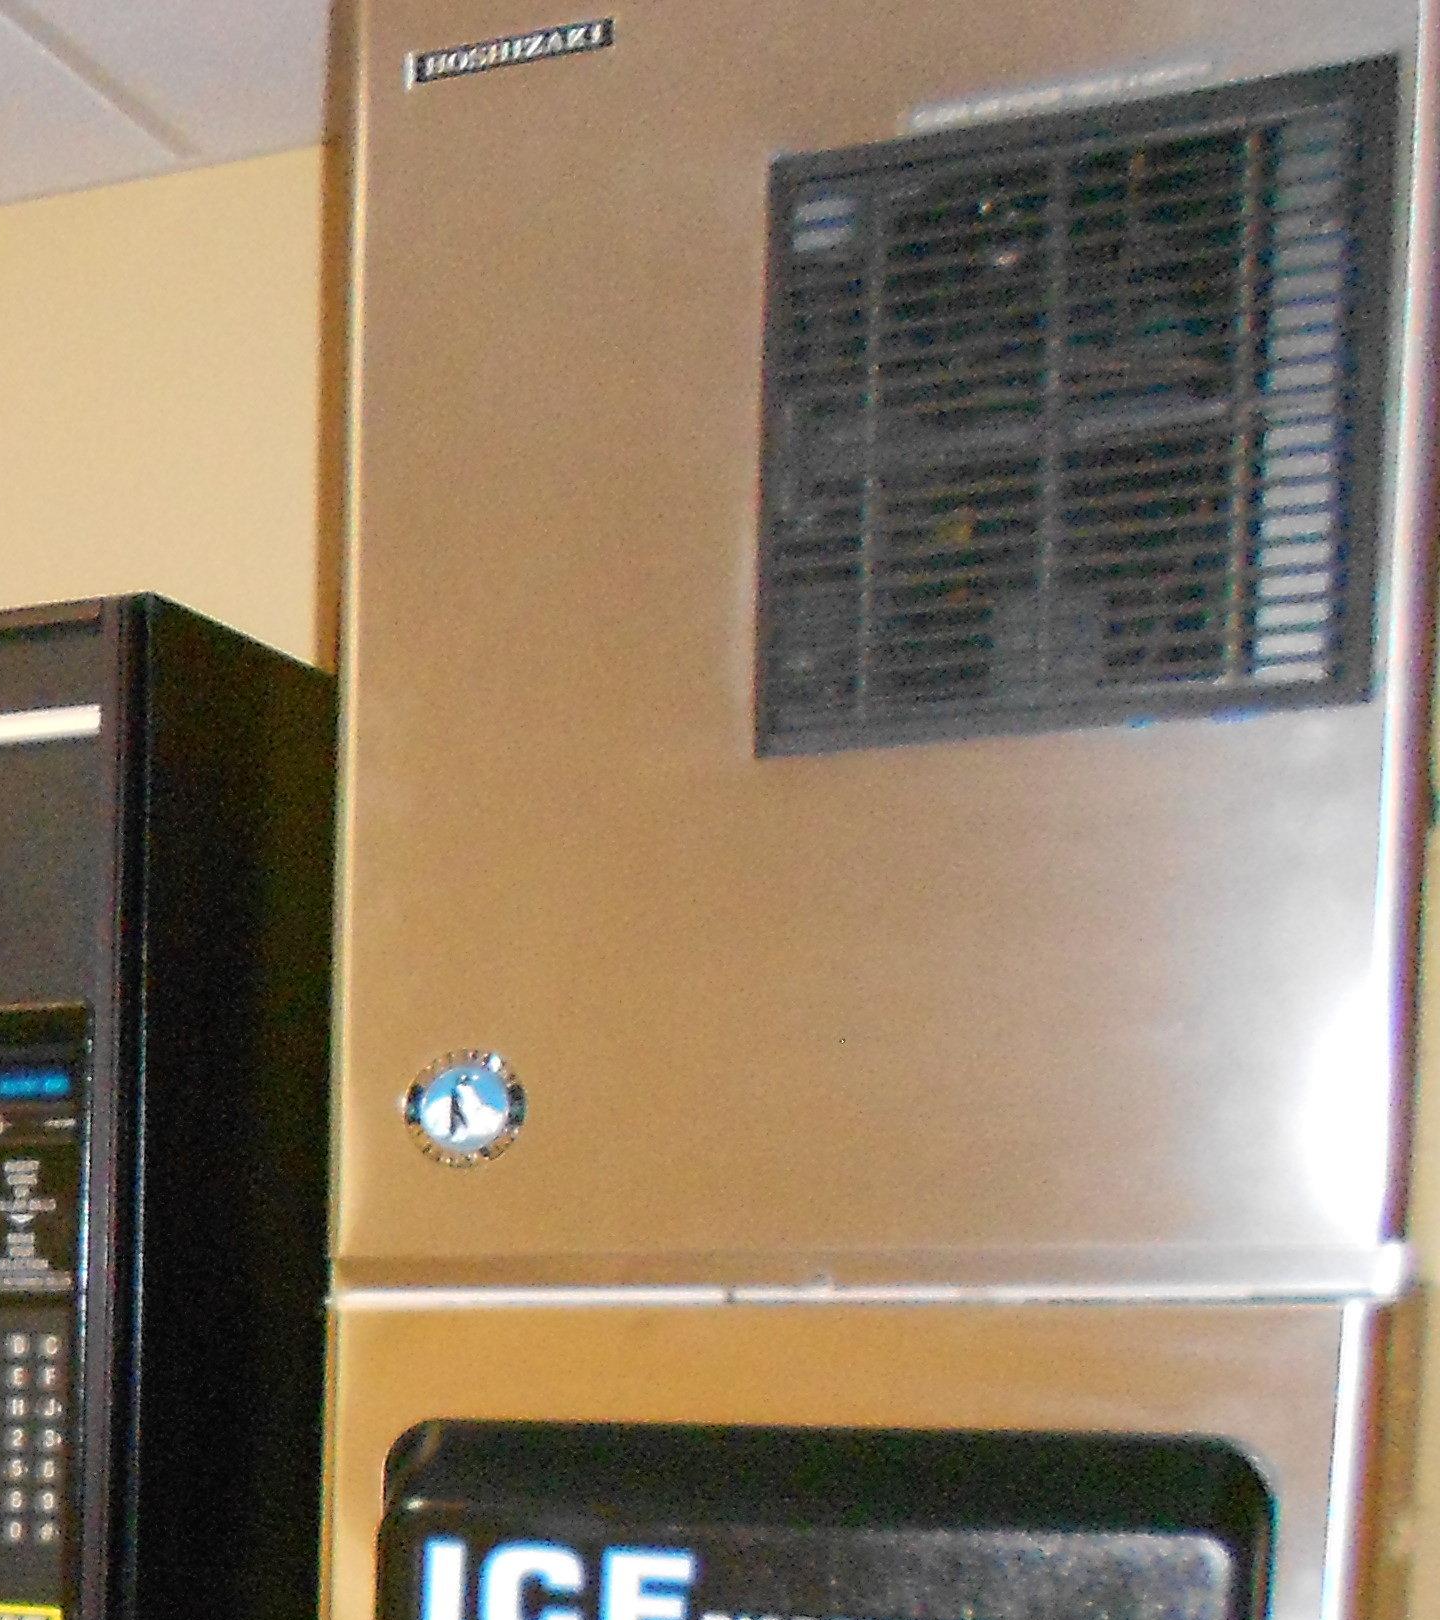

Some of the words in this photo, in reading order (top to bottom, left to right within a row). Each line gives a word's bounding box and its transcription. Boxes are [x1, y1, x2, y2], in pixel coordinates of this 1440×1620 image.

[425, 23, 604, 77] HOSHIZAKI
[46, 1336, 58, 1354] C
[44, 1398, 56, 1415] J
[13, 1429, 23, 1447] 2
[11, 1490, 22, 1508] 8
[10, 1521, 21, 1538] 0
